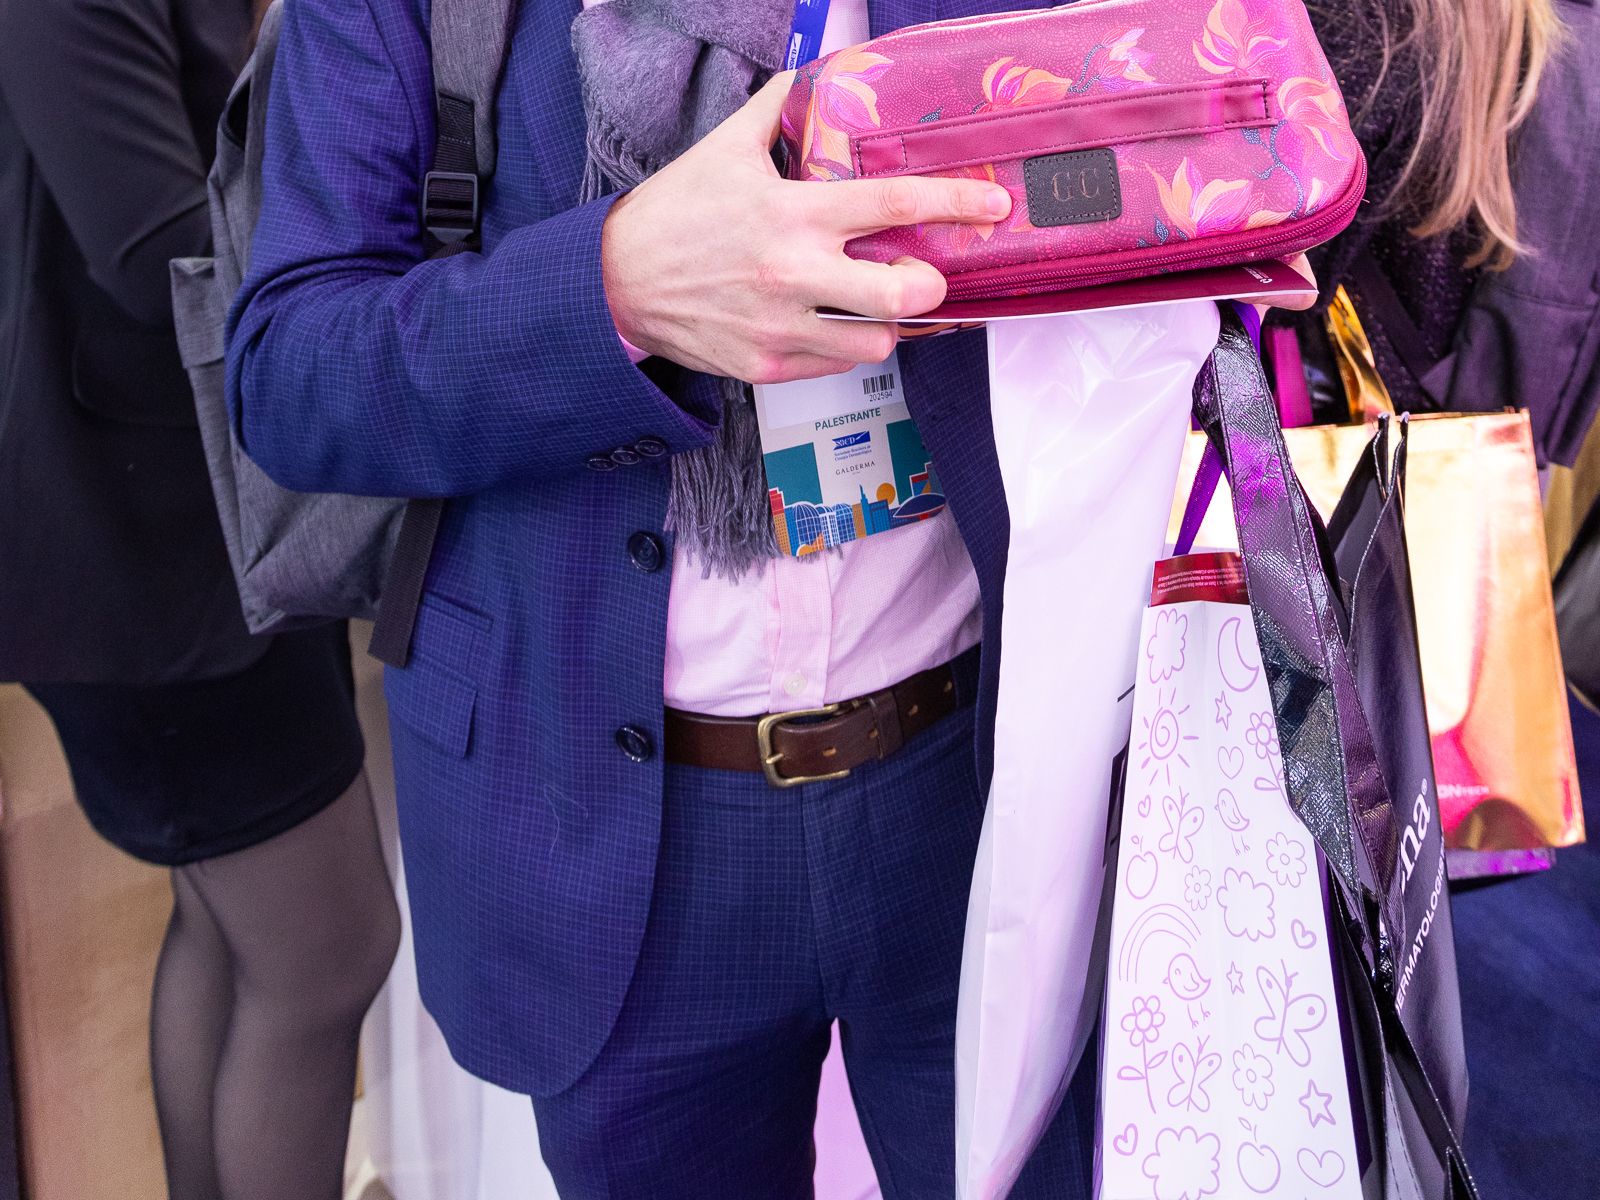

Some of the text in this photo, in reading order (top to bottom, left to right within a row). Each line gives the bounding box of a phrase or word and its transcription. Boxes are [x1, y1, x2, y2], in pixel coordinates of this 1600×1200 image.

[1051, 167, 1101, 202] GC
[814, 406, 882, 432] PALESTRANTE
[835, 460, 876, 476] GALDERMA
[1394, 836, 1445, 1013] ERMATOLOGIS
